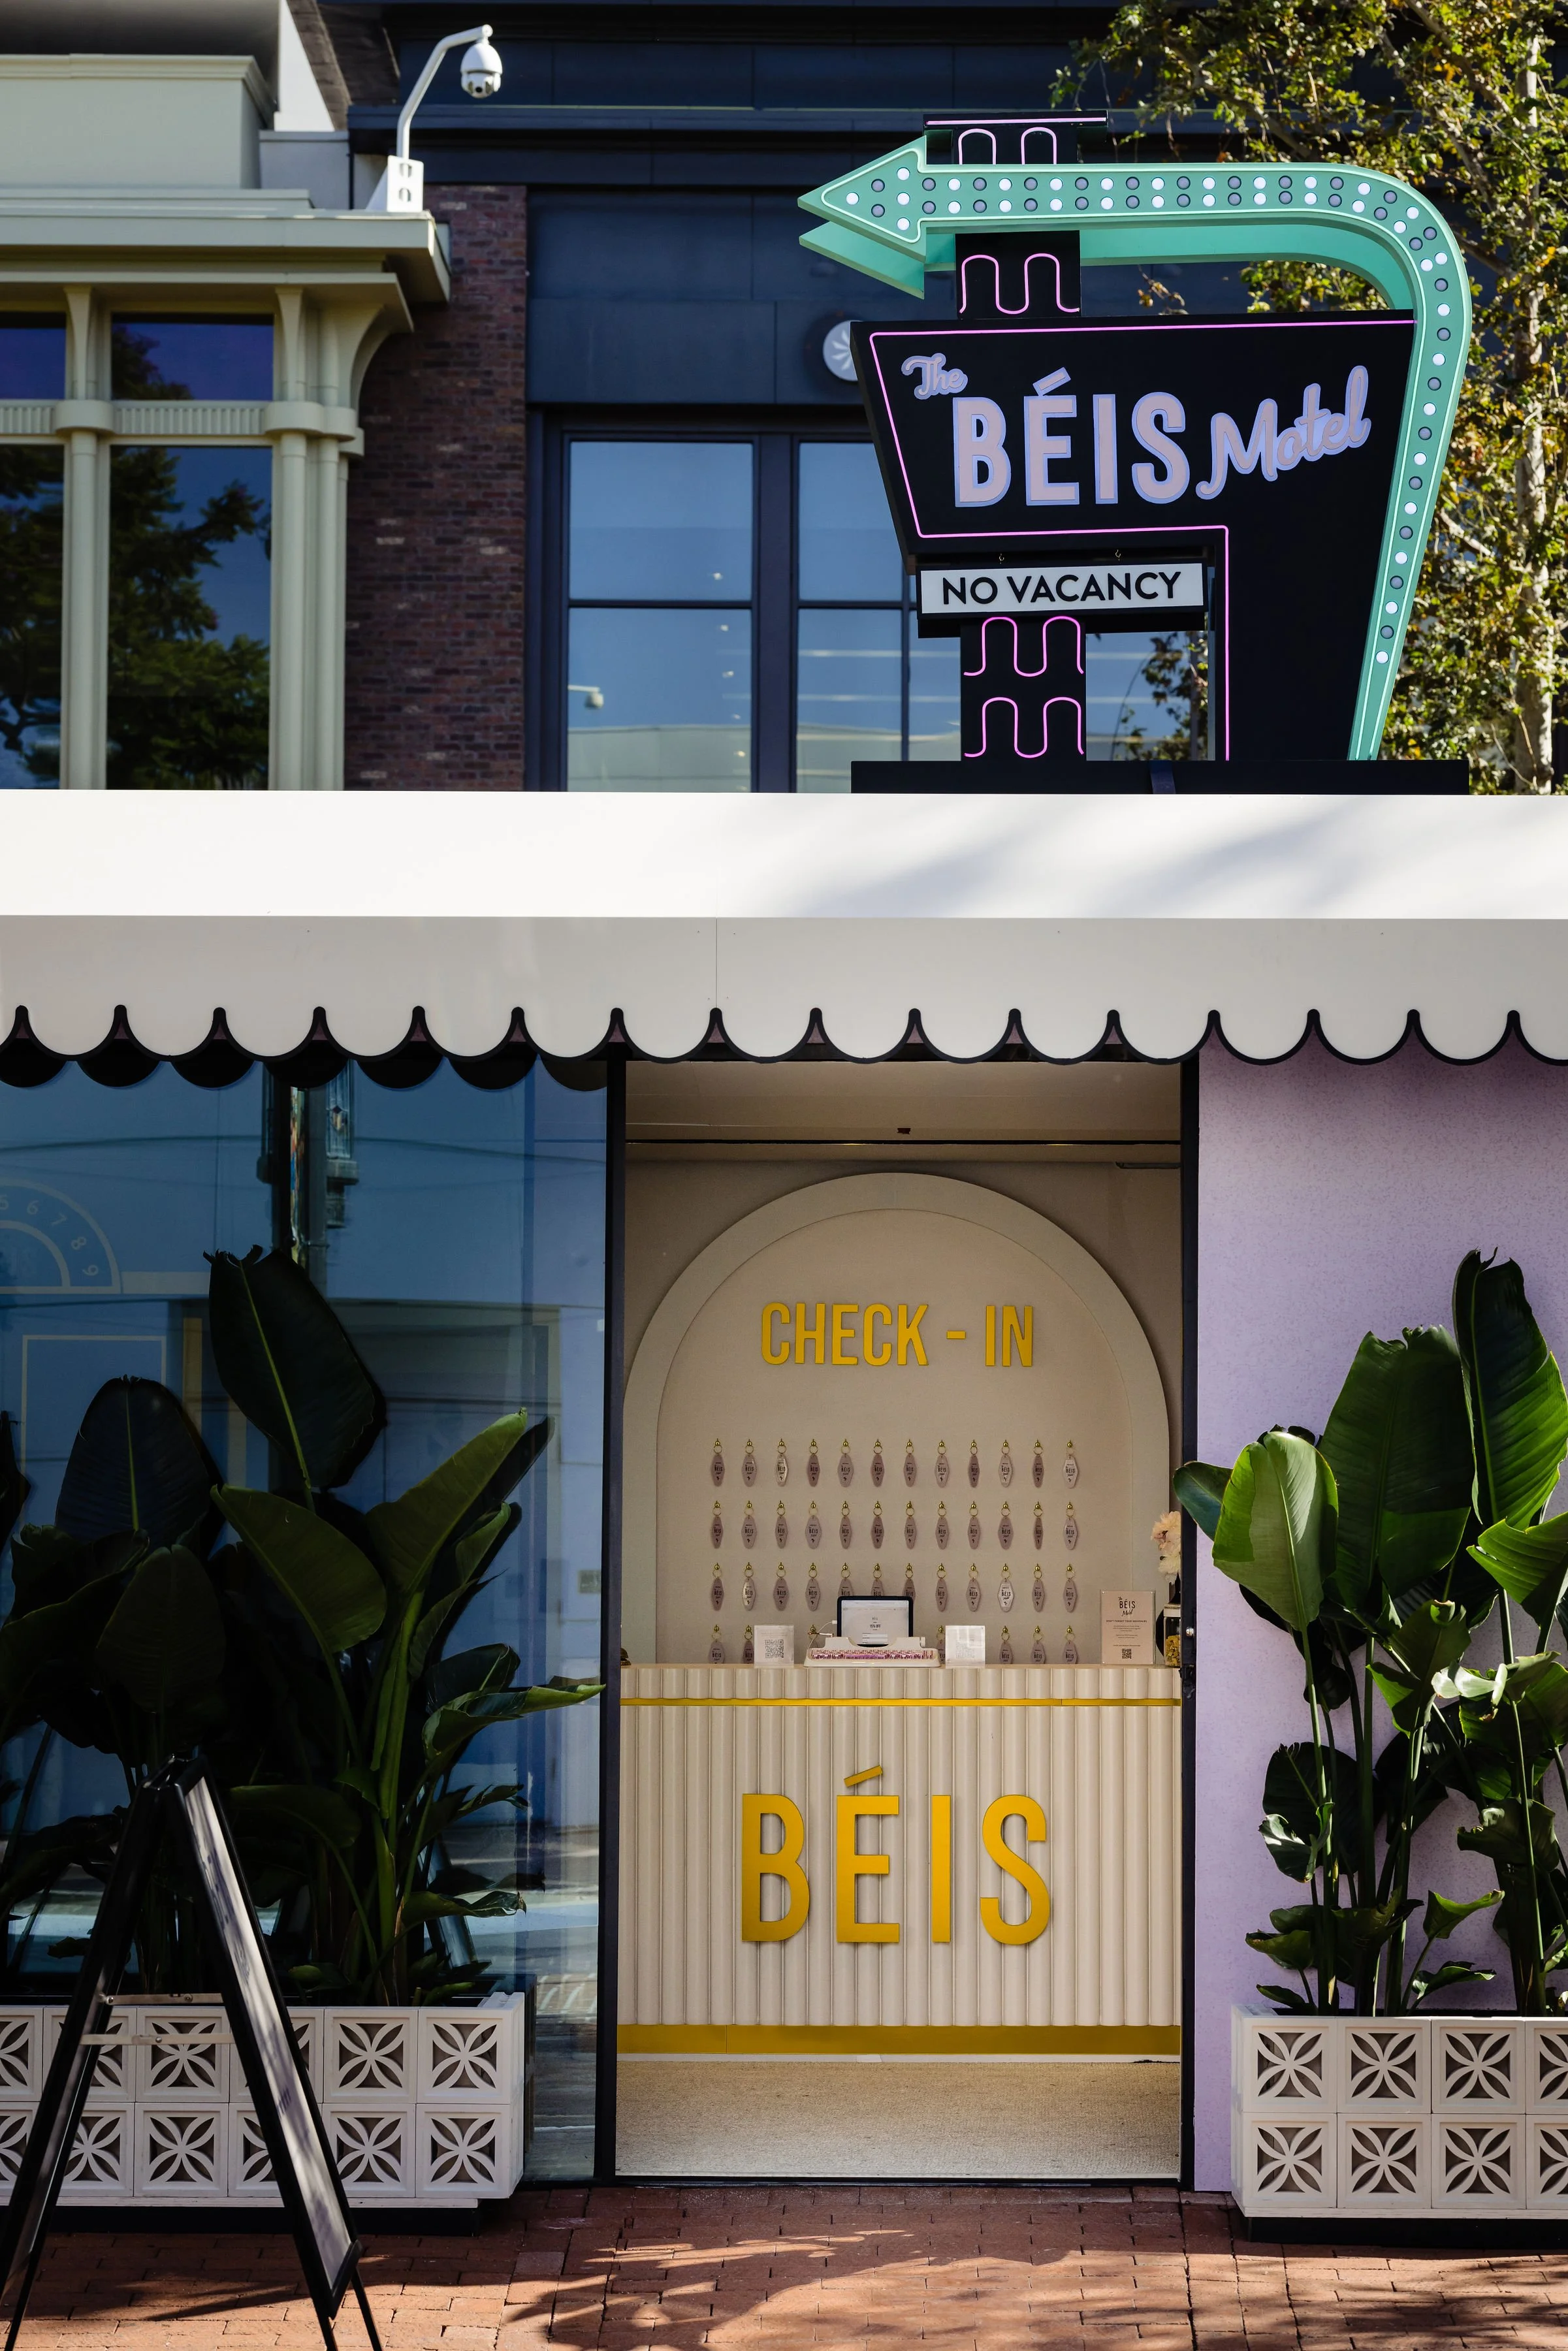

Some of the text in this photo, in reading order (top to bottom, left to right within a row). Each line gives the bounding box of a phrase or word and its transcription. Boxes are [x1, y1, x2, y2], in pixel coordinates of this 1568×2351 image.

[901, 353, 1371, 507] The BÉIS Motel
[942, 570, 1181, 605] NO VACANCY
[27, 1200, 39, 1215] 6
[71, 1236, 87, 1250] 8
[761, 1302, 929, 1366] CHECK
[985, 1305, 1033, 1367] IN
[1119, 1599, 1136, 1608] BÉIS
[742, 1765, 1050, 1945] BÉIS
